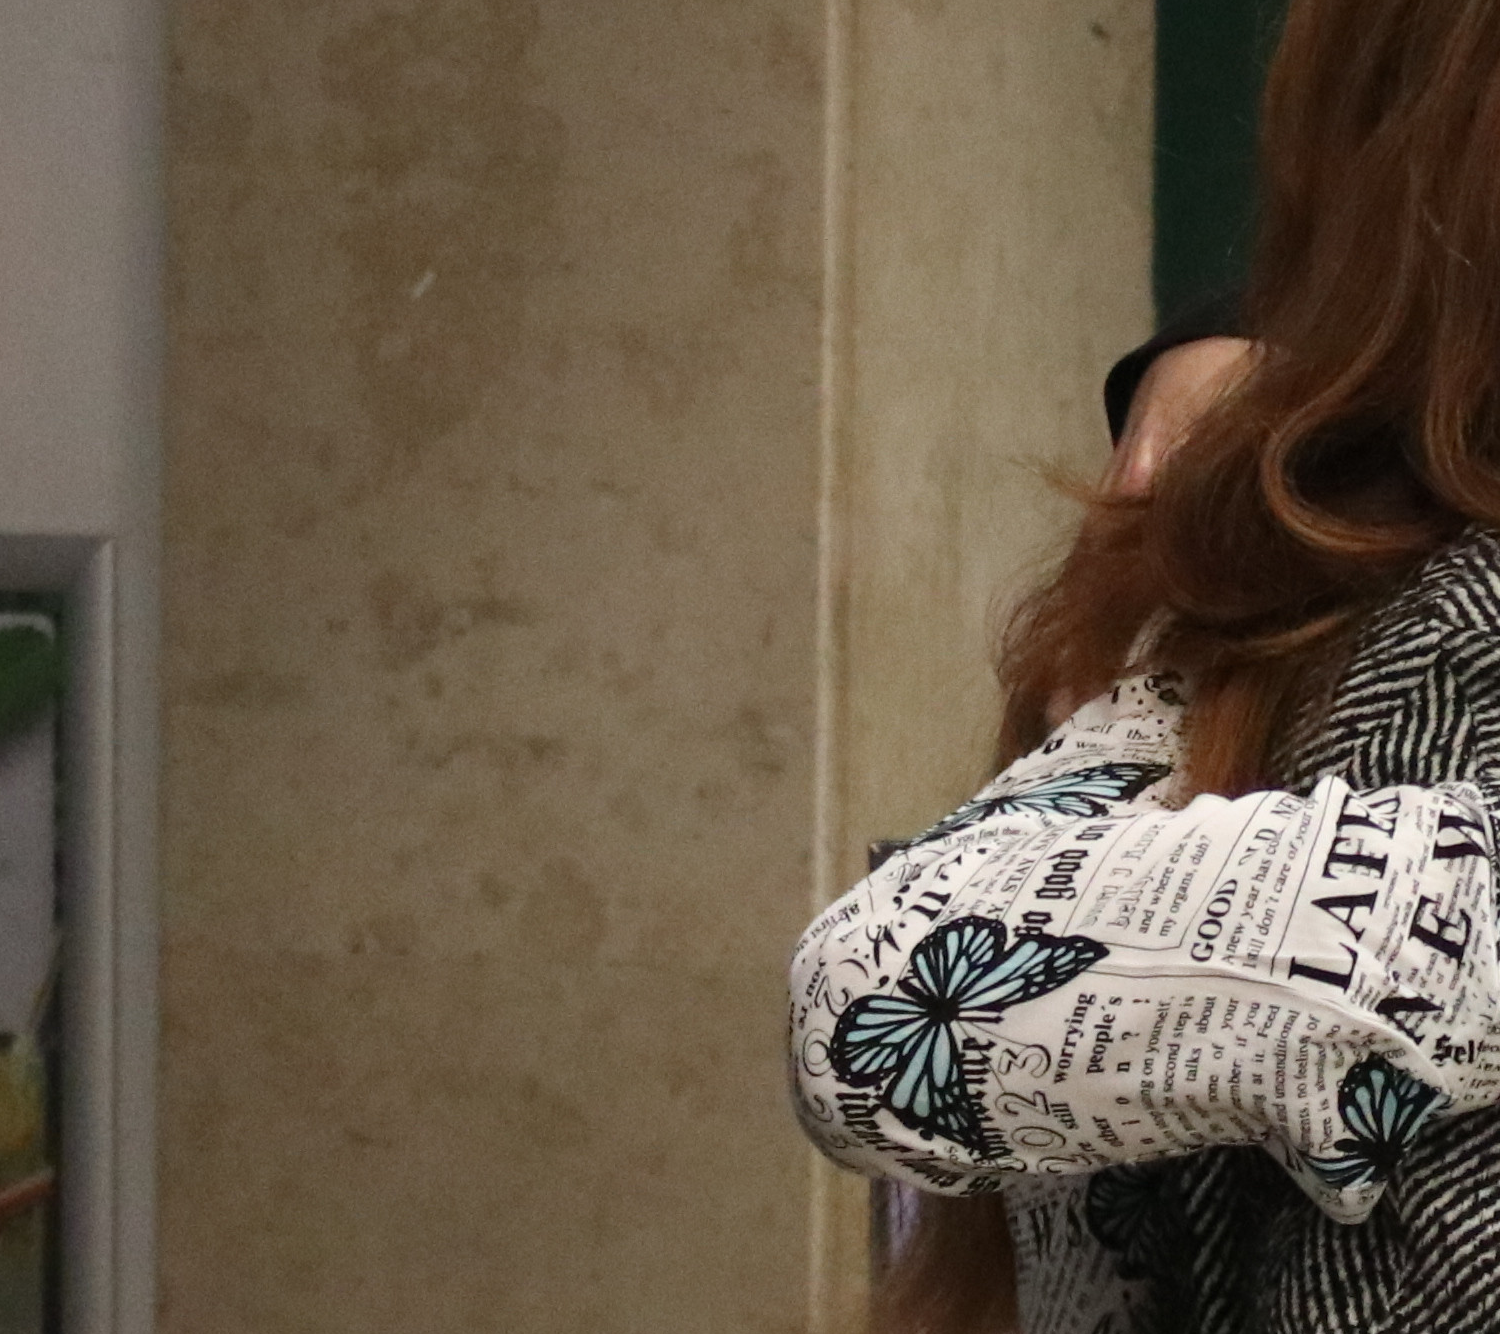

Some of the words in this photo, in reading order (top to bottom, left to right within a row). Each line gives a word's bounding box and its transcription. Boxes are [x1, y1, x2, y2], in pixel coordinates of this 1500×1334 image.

[1034, 849, 1090, 901] good
[1272, 863, 1292, 894] care
[1287, 840, 1299, 861] of
[1138, 909, 1155, 934] and
[1150, 866, 1175, 906] where
[1189, 878, 1238, 963] GOOD
[1226, 922, 1245, 954] new
[1240, 884, 1260, 920] year
[1251, 857, 1272, 883] has
[1158, 916, 1177, 937] my
[1172, 1011, 1193, 1039] step
[1179, 995, 1195, 1008] is
[1236, 1035, 1248, 1048] if
[1243, 1002, 1261, 1028] you
[1256, 1004, 1282, 1039] Feed
[1053, 992, 1097, 1085] worrying
[1185, 1047, 1202, 1082] talks
[1194, 996, 1218, 1034] about
[1211, 1042, 1226, 1060] of
[1221, 998, 1240, 1031] your
[1273, 1009, 1301, 1099] unconditional
[1143, 1057, 1154, 1076] on
[1163, 1042, 1181, 1093] second
[1297, 1083, 1308, 1099] no
[1307, 1014, 1321, 1031] of
[1050, 1102, 1079, 1130] still
[1319, 1098, 1330, 1112] is
[1319, 1116, 1333, 1154] There
